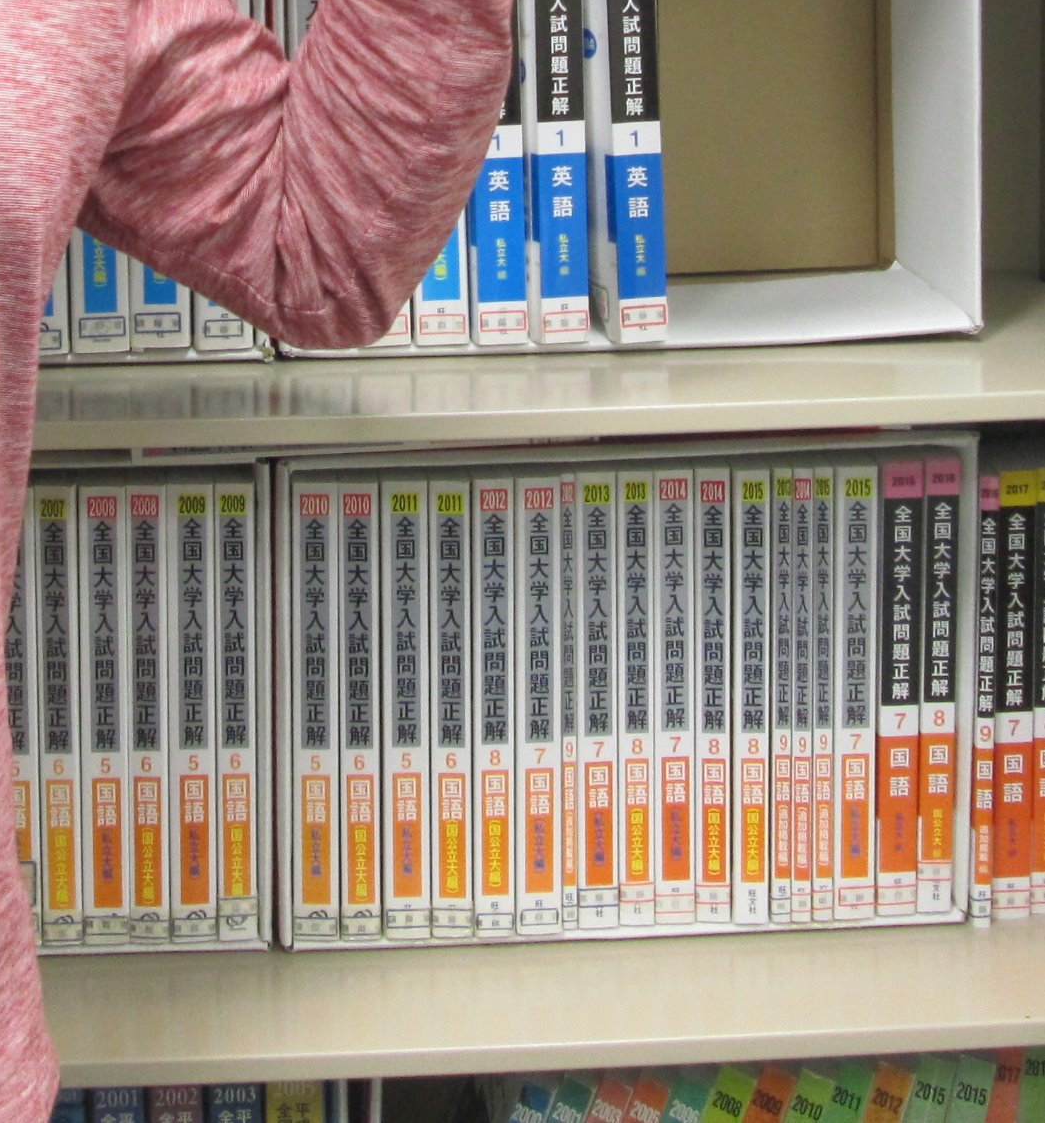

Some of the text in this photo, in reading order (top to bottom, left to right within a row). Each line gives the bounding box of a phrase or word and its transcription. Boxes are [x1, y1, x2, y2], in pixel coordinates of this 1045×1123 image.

[555, 129, 565, 147] 1
[629, 130, 639, 148] 1
[488, 170, 511, 222] 英語
[551, 165, 574, 219] 英語
[627, 166, 650, 219] 英語
[132, 496, 158, 516] 2008
[179, 495, 206, 515] 2009
[344, 496, 371, 514] 2010
[392, 494, 418, 512] 2011
[526, 490, 553, 509] 2012
[584, 485, 610, 503] 2013
[702, 483, 724, 501] 2014
[845, 478, 871, 497] 2015
[627, 504, 648, 730] 全国大学入試問題正解
[703, 505, 724, 729] 全国大学入試問題正解
[892, 505, 913, 700] 全国大学入試問題正解
[979, 517, 997, 713] 全国大学入試問題正解
[94, 521, 116, 749] 全国大学入試問題正解
[135, 520, 158, 749] 全国大学入試問題正解
[182, 517, 204, 746] 全国大学入試問題正解
[395, 516, 418, 769] 全国大学入試問題正解 5
[440, 517, 462, 744] 全国大学入試問題正解
[44, 522, 70, 828] 全国大学入試問題正解 国語
[305, 518, 326, 823] 全国大学入試問題正解 国語
[743, 504, 764, 805] 全国大学入試問題正解 国語
[184, 779, 205, 823] 国語
[795, 761, 810, 803] 国語
[975, 760, 993, 810] 国語
[212, 1085, 257, 1106] 2003
[712, 1090, 743, 1118] 2008
[791, 1094, 824, 1121] 2010
[832, 1086, 862, 1111] 2011
[872, 1087, 903, 1115] 2012
[915, 1081, 946, 1105] 2015
[956, 1083, 987, 1106] 2015
